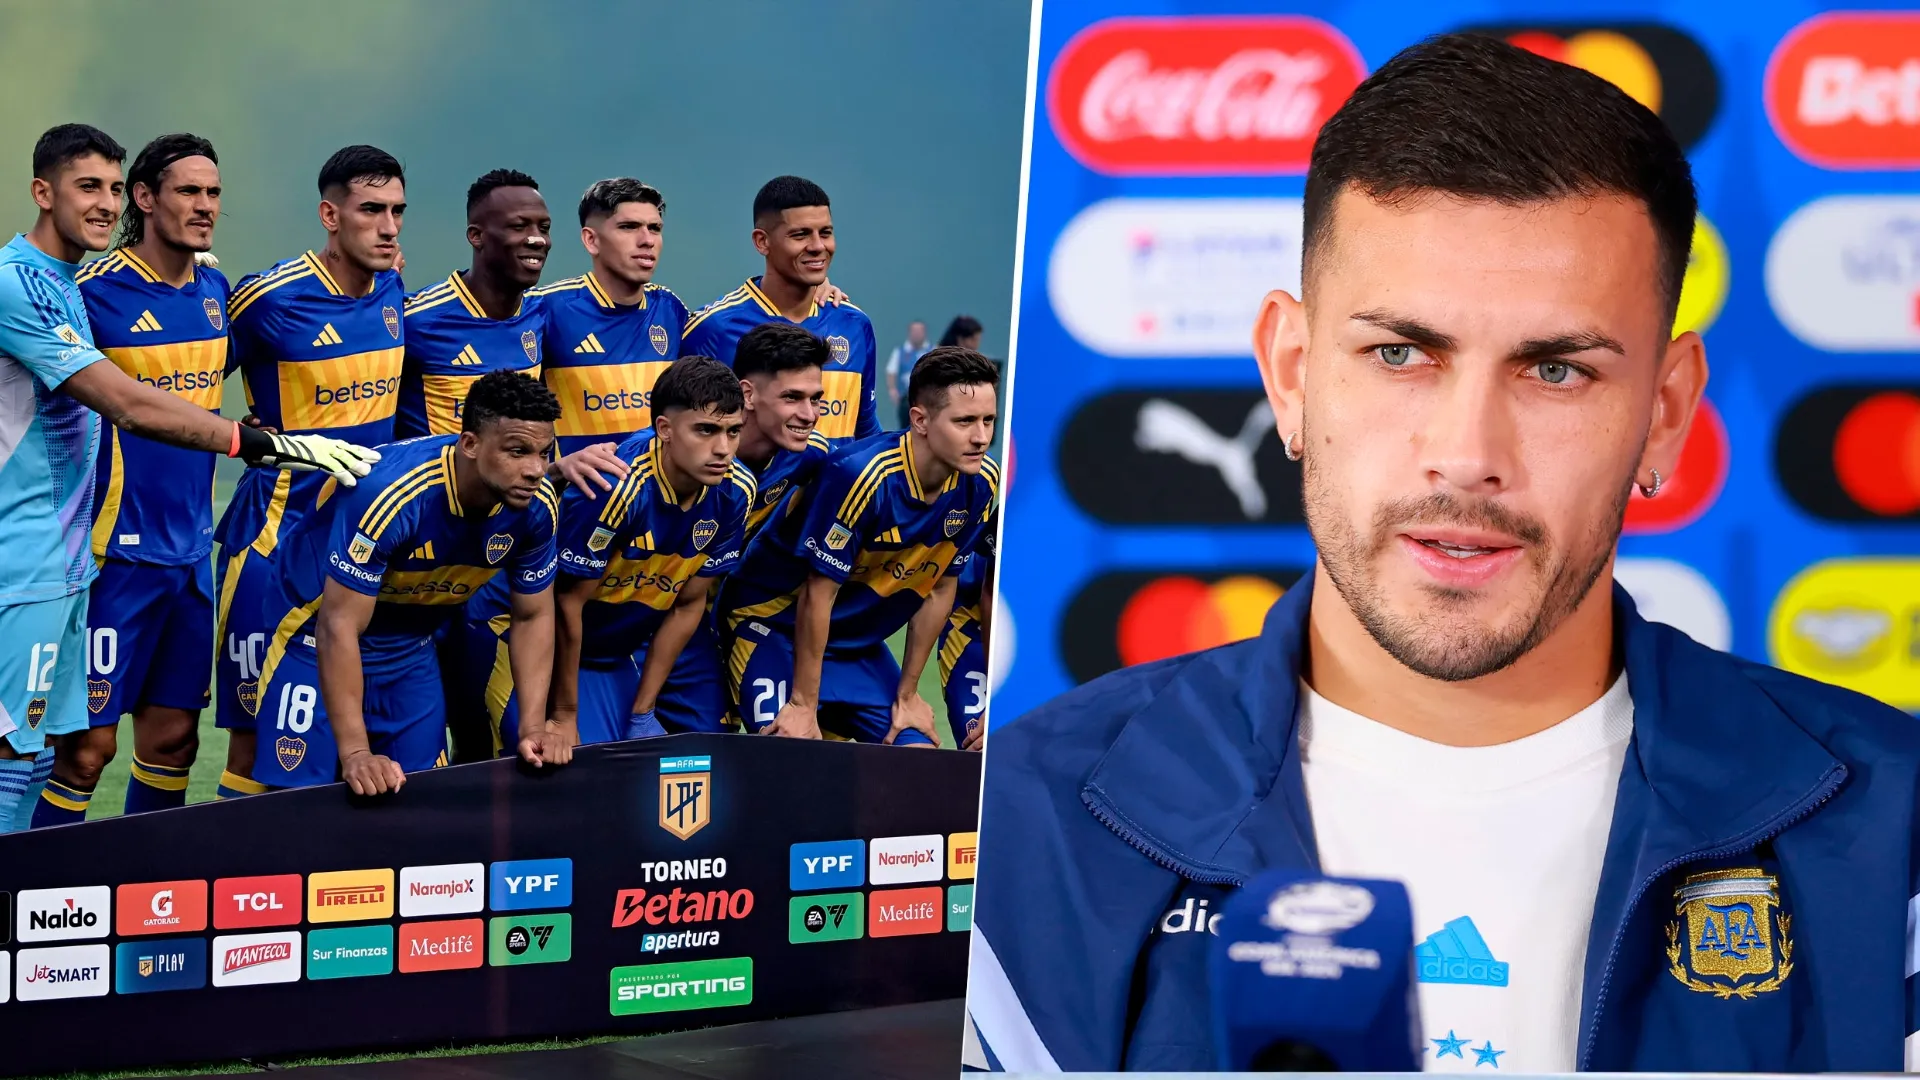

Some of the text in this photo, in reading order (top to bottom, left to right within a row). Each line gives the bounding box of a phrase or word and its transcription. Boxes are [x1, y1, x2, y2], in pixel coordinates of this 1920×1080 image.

[584, 389, 652, 411] betss
[694, 529, 713, 537] CABJ
[946, 519, 965, 527] CABJ
[488, 543, 508, 551] CABJ
[603, 571, 685, 594] betsso
[229, 632, 265, 679] 40
[27, 642, 59, 692] 12
[241, 692, 258, 700] CAB
[753, 678, 788, 722] 21
[28, 707, 44, 716] CABJ
[276, 682, 317, 733] 18
[279, 746, 301, 756] CABJ
[677, 759, 694, 768] AFA
[667, 782, 703, 829] LPF
[803, 856, 853, 874] YPF
[879, 849, 935, 867] NaranjaX
[641, 857, 727, 883] TORNEO
[410, 879, 474, 898] NaranjaX
[504, 874, 559, 894] YPF
[233, 892, 283, 912] TCL
[317, 885, 385, 907] PIRELLI
[611, 887, 754, 928] Betano
[808, 911, 822, 920] EA
[879, 903, 934, 922] Medifé
[952, 904, 969, 914] Sur
[30, 907, 97, 930] Naldo
[143, 917, 180, 926] GATORADE
[510, 932, 526, 942] EA
[1696, 902, 1766, 960] AFA
[410, 935, 473, 957] Medifé
[509, 940, 527, 949] SPORTS
[644, 930, 720, 954] apertura
[225, 942, 288, 971] MANTECOL
[312, 945, 388, 960] Sur Finanzas
[158, 953, 185, 973] PLAY
[1417, 957, 1505, 982] didas
[26, 964, 100, 984] JetSMART
[619, 974, 664, 983] PRESENTADO
[618, 976, 746, 1001] SPORTING
